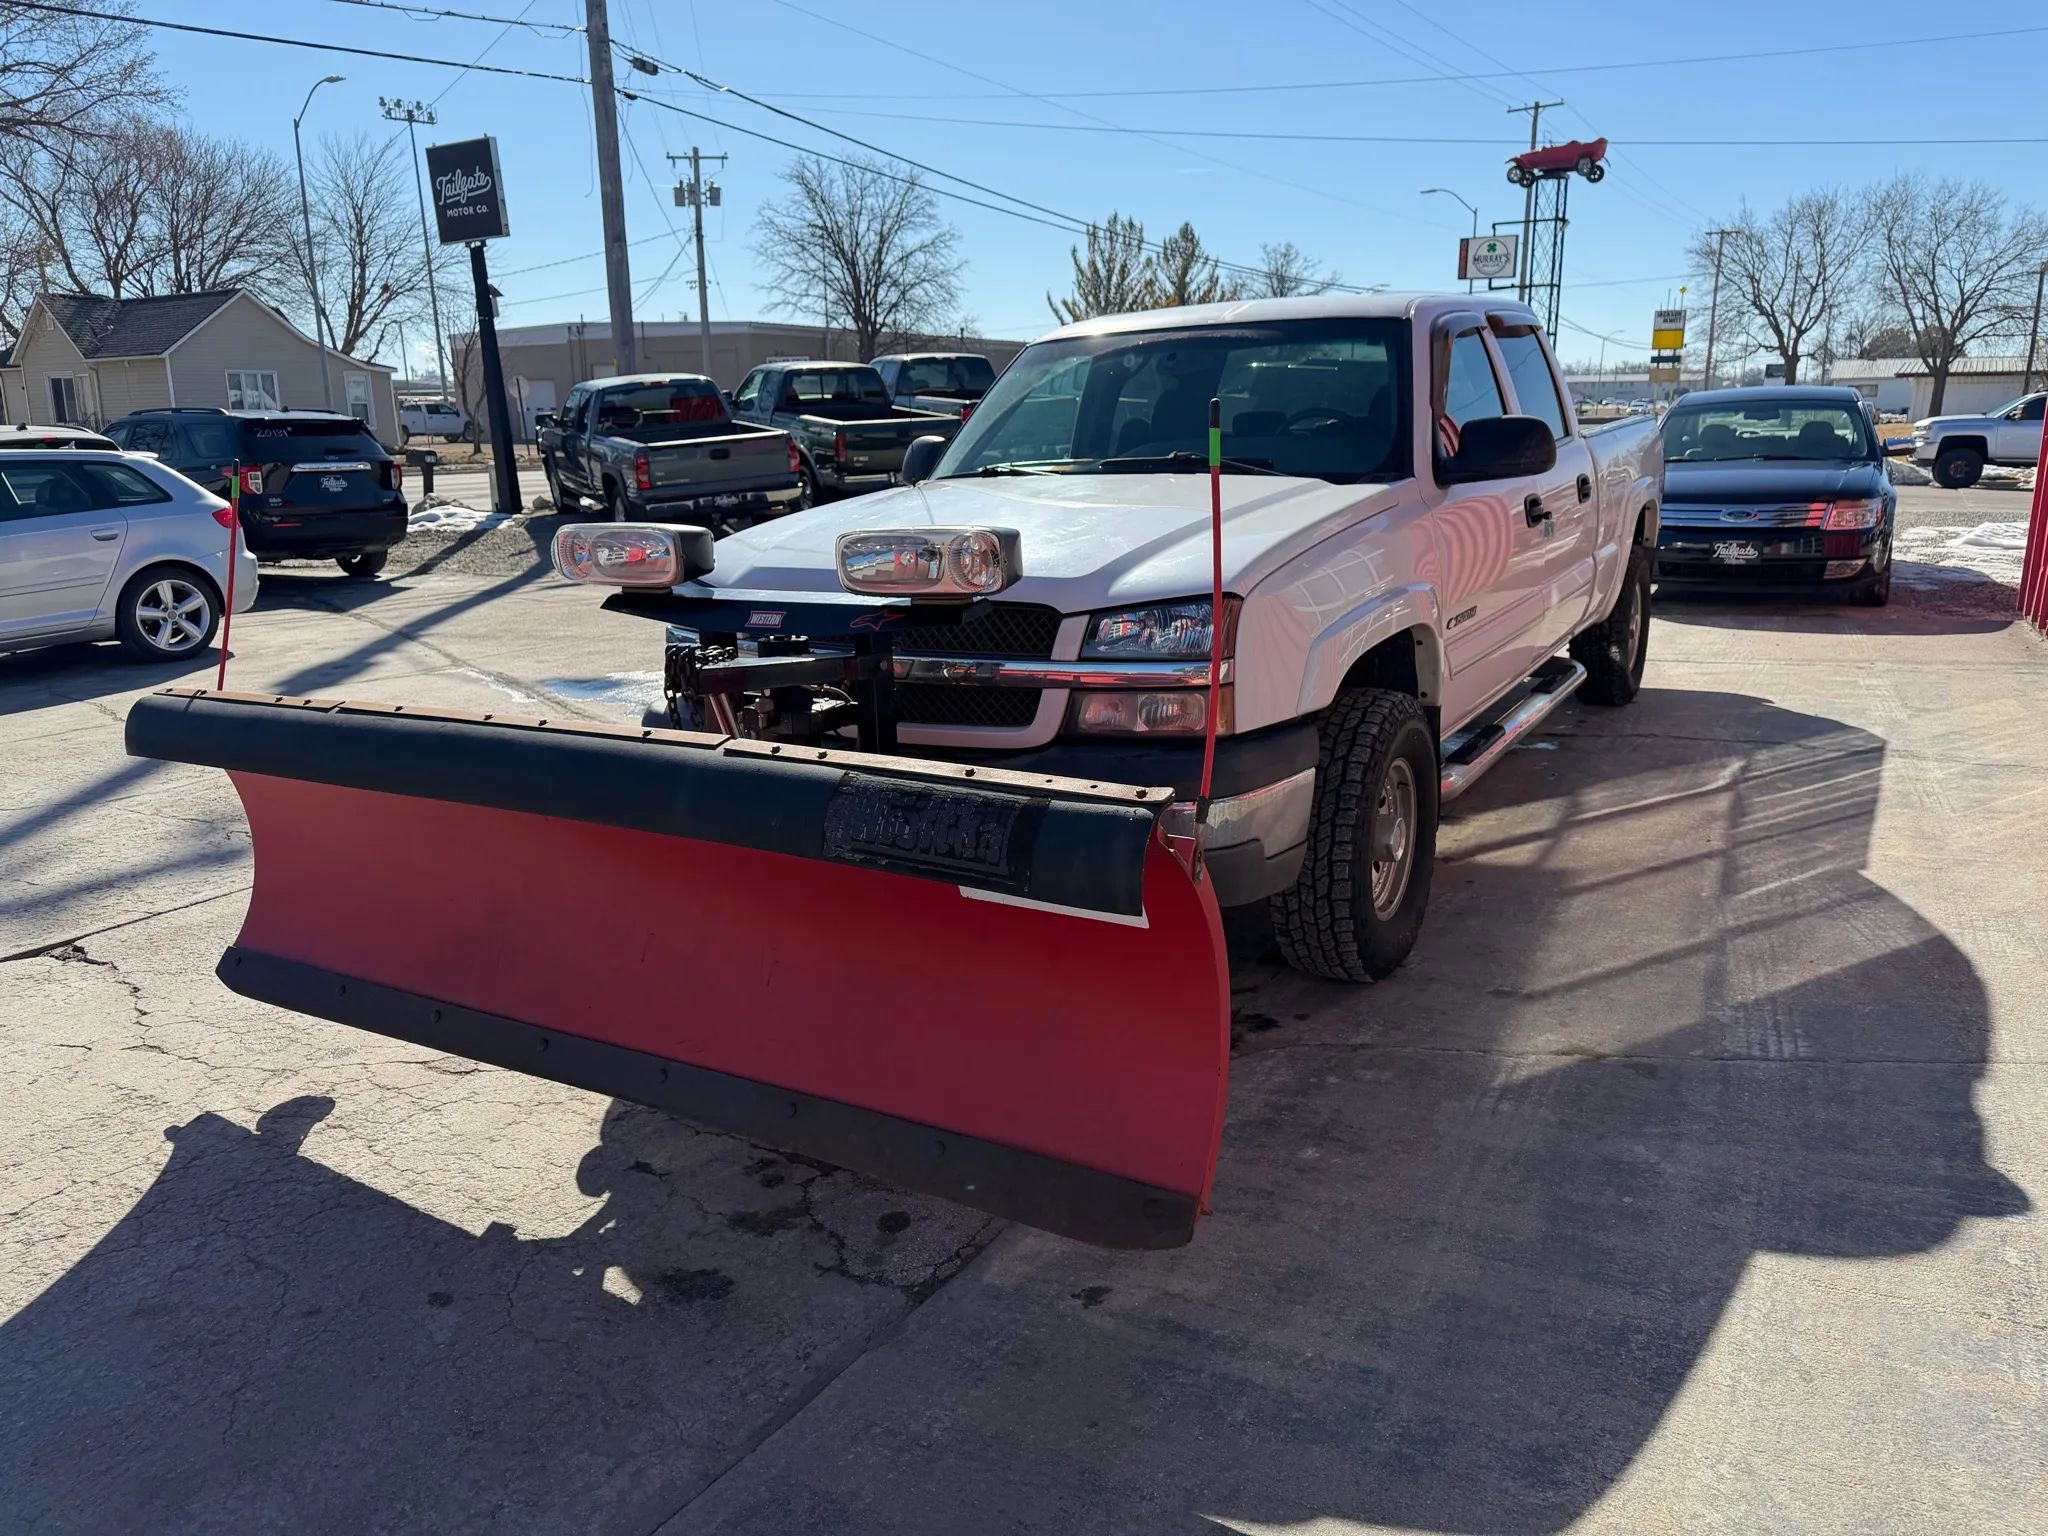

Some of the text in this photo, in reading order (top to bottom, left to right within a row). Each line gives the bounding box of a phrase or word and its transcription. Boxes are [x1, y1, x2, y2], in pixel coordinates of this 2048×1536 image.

[436, 165, 491, 205] Tailgate
[446, 204, 489, 218] MOTOR CO.
[1712, 542, 1759, 559] Tailgate
[750, 613, 782, 625] WESTERN
